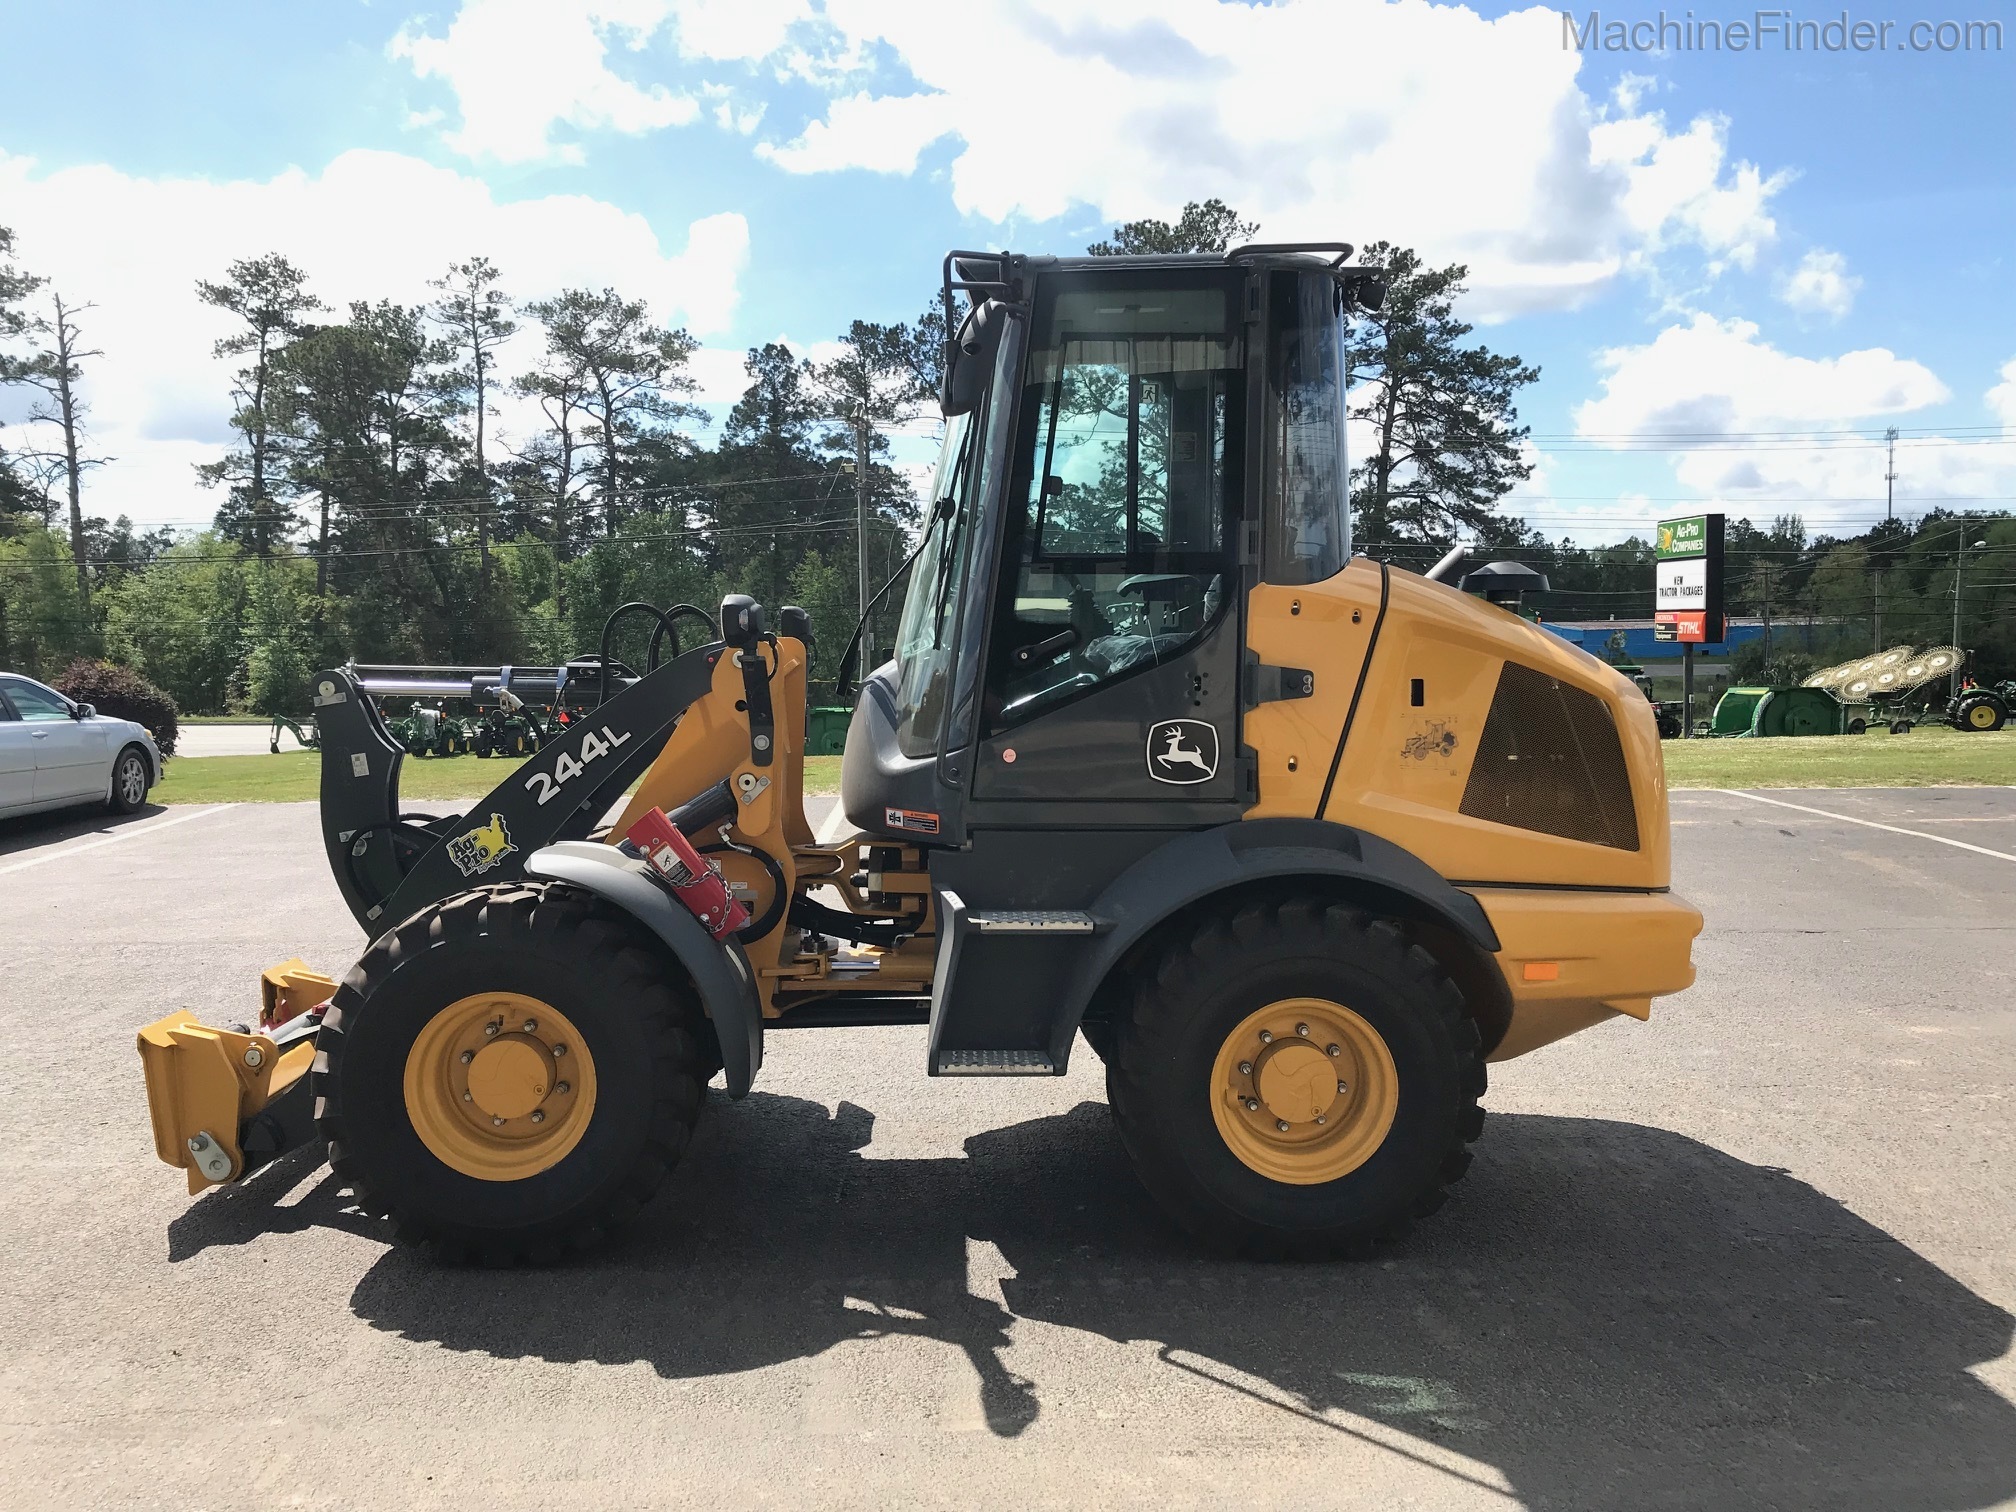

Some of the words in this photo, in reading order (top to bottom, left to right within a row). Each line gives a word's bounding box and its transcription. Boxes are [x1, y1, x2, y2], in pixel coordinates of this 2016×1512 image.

[1674, 576, 1683, 585] NEW
[1659, 587, 1677, 597] TRACTOR
[1680, 586, 1703, 596] PACKAGES
[1679, 621, 1700, 634] STIHL
[524, 725, 632, 806] 244L
